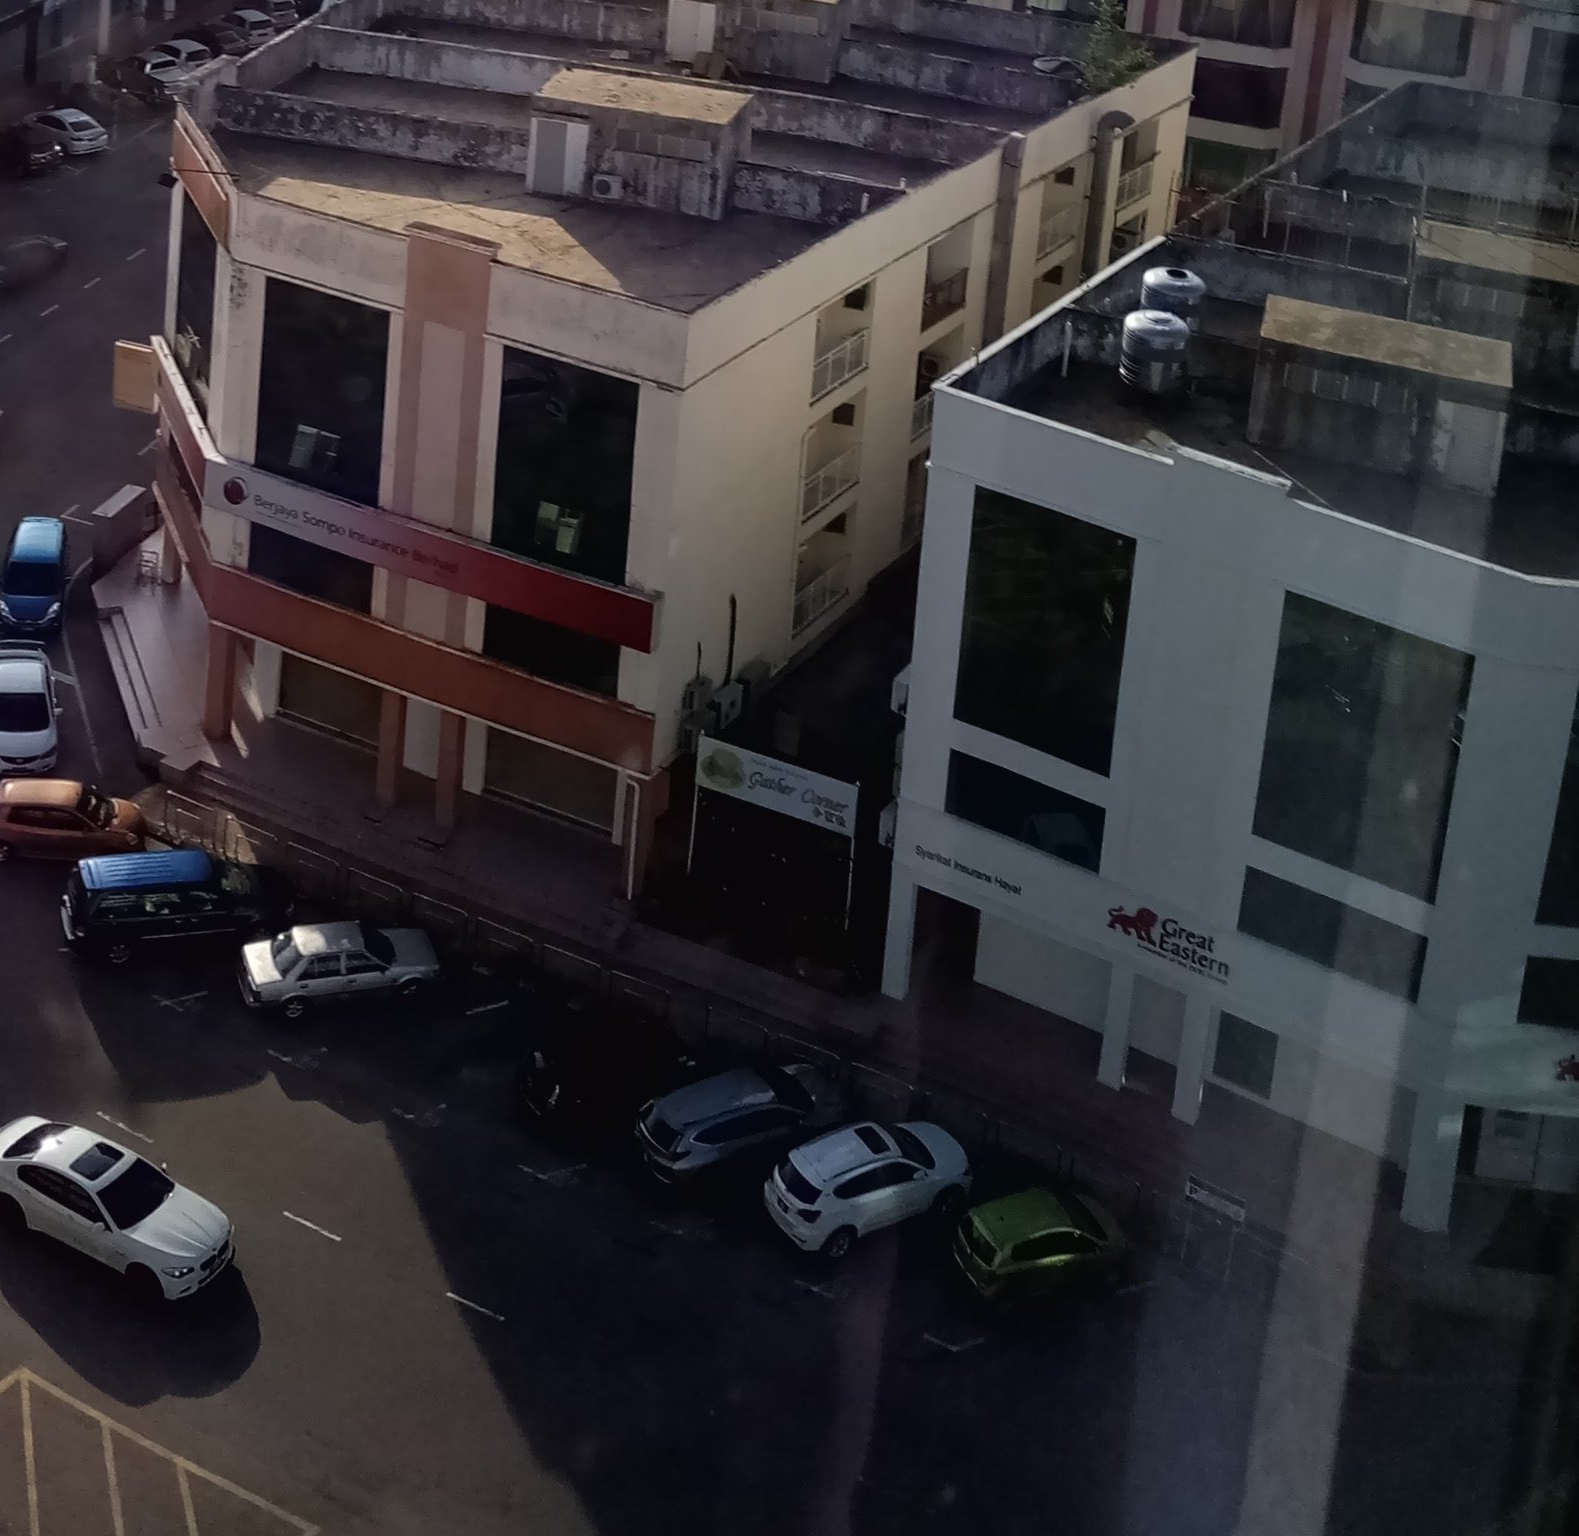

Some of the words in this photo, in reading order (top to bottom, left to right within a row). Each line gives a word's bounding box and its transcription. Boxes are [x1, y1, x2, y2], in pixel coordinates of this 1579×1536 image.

[253, 494, 299, 520] Berjaya
[302, 511, 346, 537] Sompo
[348, 526, 410, 557] Insurance
[410, 548, 459, 575] Berhad
[800, 787, 850, 814] Corner
[994, 875, 1022, 896] Hayat
[1160, 917, 1215, 953] Great
[1158, 931, 1230, 977] Eastern
